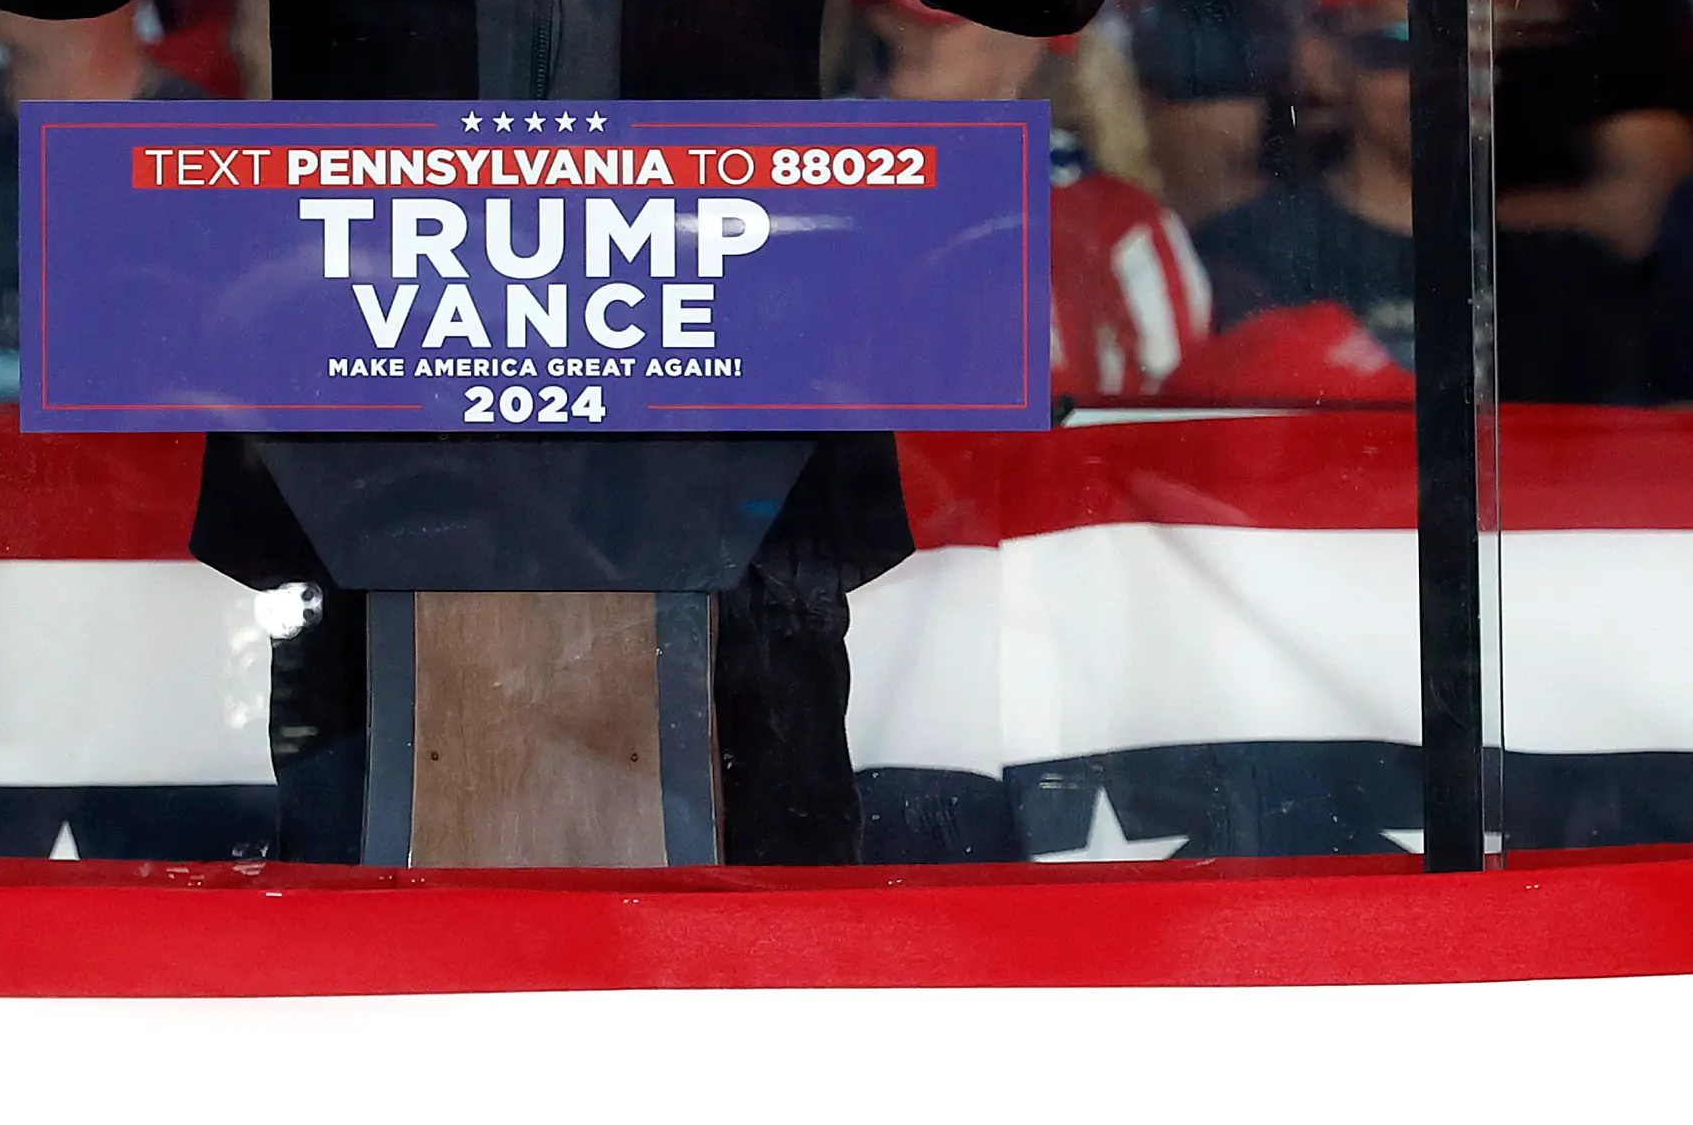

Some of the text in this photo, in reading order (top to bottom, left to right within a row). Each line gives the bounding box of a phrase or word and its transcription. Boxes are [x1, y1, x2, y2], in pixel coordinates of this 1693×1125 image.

[146, 148, 925, 186] TEXT PENNSYLVANIA TO 88022
[299, 198, 772, 279] TRUMP
[352, 282, 715, 349] VANCE
[329, 358, 743, 377] MAKE AMERICA GREAT AGAIN!
[464, 385, 607, 423] 2024
